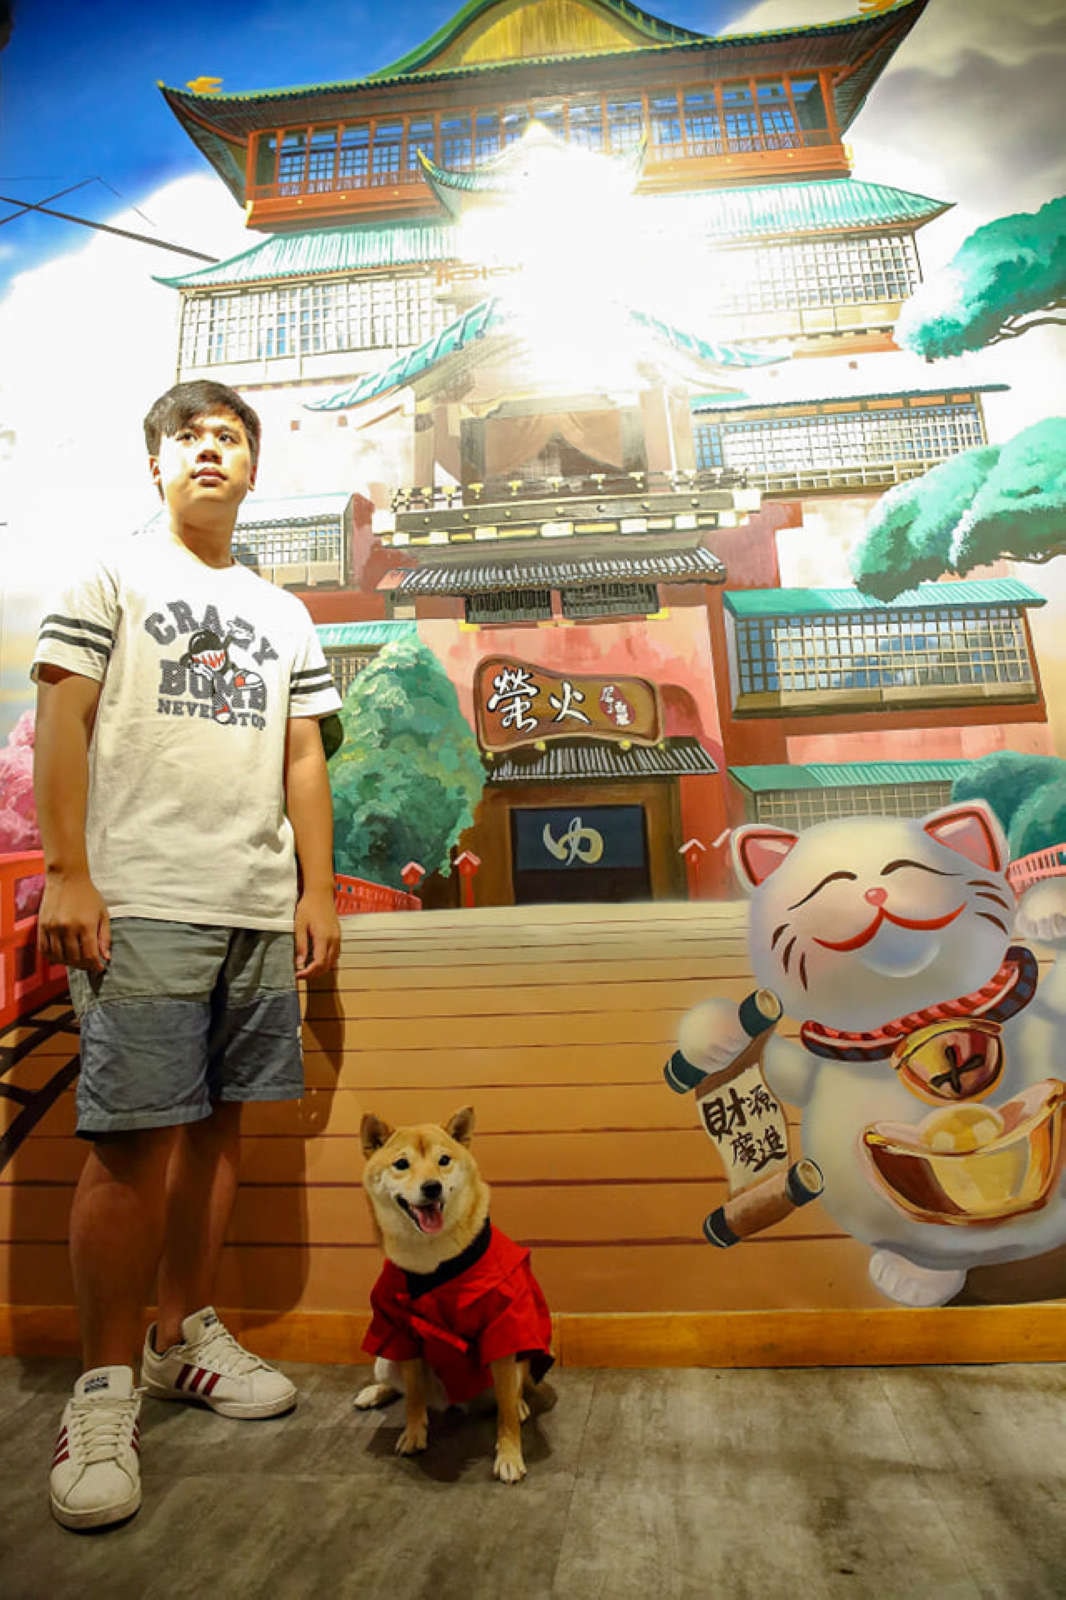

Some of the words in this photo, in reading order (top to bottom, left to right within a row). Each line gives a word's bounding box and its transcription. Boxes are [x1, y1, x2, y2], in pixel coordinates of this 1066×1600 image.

[157, 698, 214, 720] NEVE
[159, 659, 268, 713] BOMB
[487, 667, 592, 734] 螢火
[543, 816, 604, 866] ゆ
[702, 1084, 778, 1144] 財源
[729, 1125, 788, 1173] 廣進
